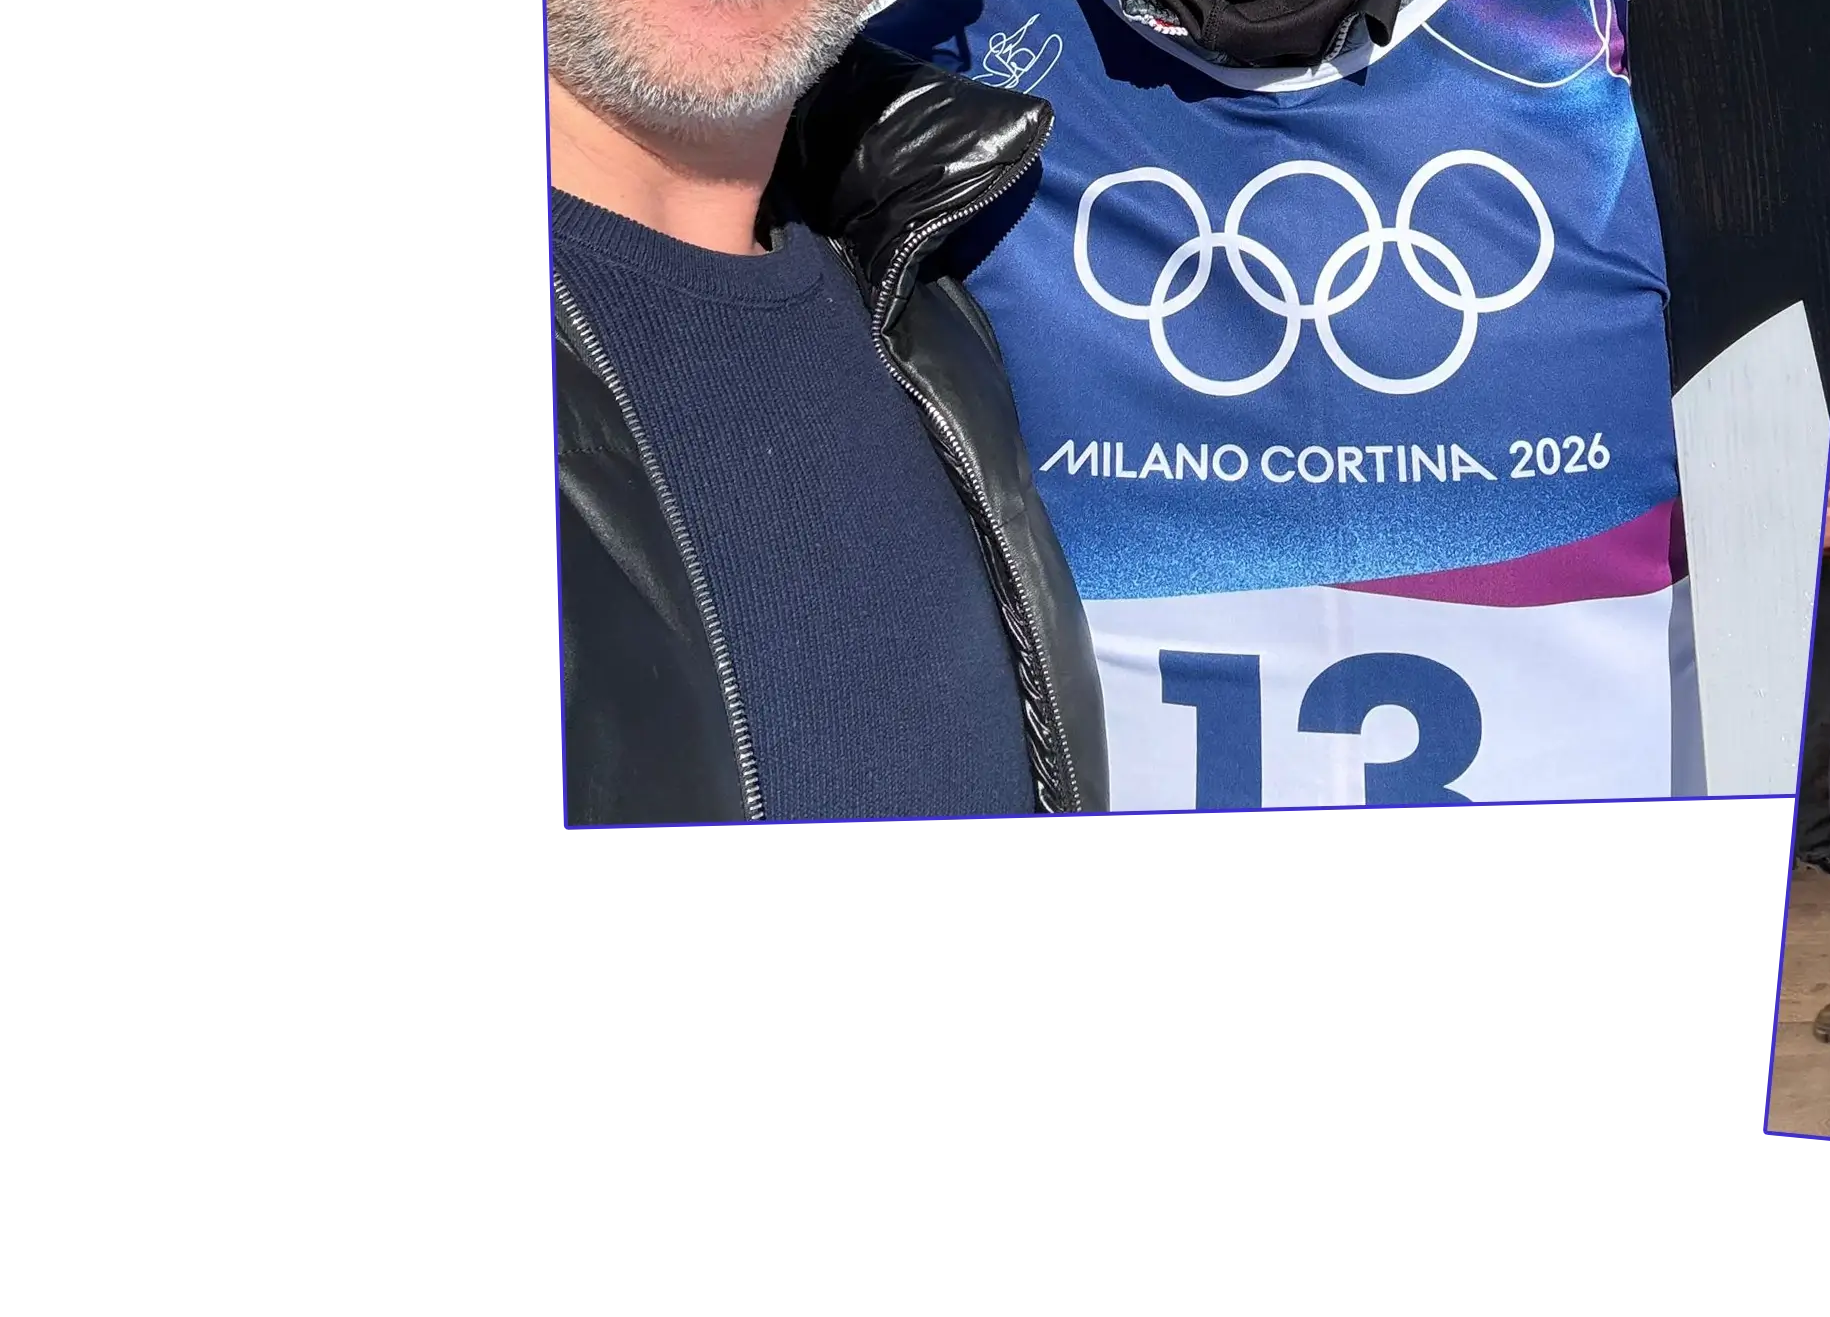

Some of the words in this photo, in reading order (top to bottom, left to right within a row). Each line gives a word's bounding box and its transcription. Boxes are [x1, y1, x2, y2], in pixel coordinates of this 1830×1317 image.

[1039, 439, 1248, 481] MILANO
[1261, 443, 1498, 483] CORTINA
[1509, 433, 1611, 478] 2026
[1159, 649, 1483, 809] 13
